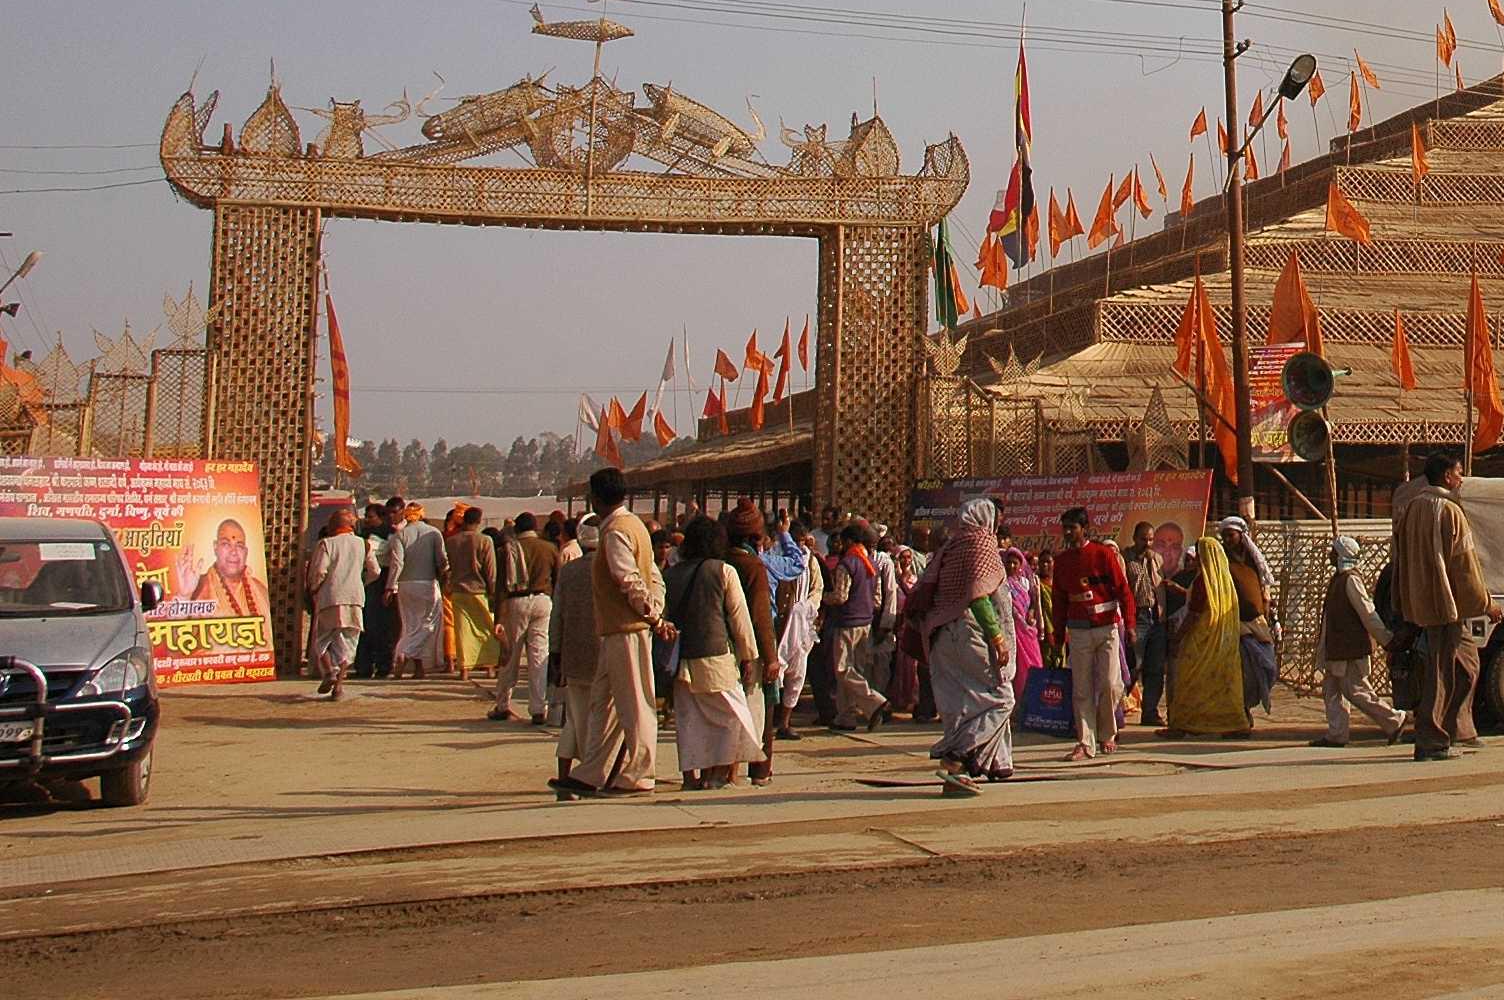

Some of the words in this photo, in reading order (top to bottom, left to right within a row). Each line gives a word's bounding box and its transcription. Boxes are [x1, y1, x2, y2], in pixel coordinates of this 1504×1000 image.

[27, 503, 53, 517] शिव,
[56, 503, 97, 517] गणपति,
[125, 504, 151, 520] विष्णु,
[171, 504, 184, 518] की
[146, 616, 266, 655] महायज्ञ
